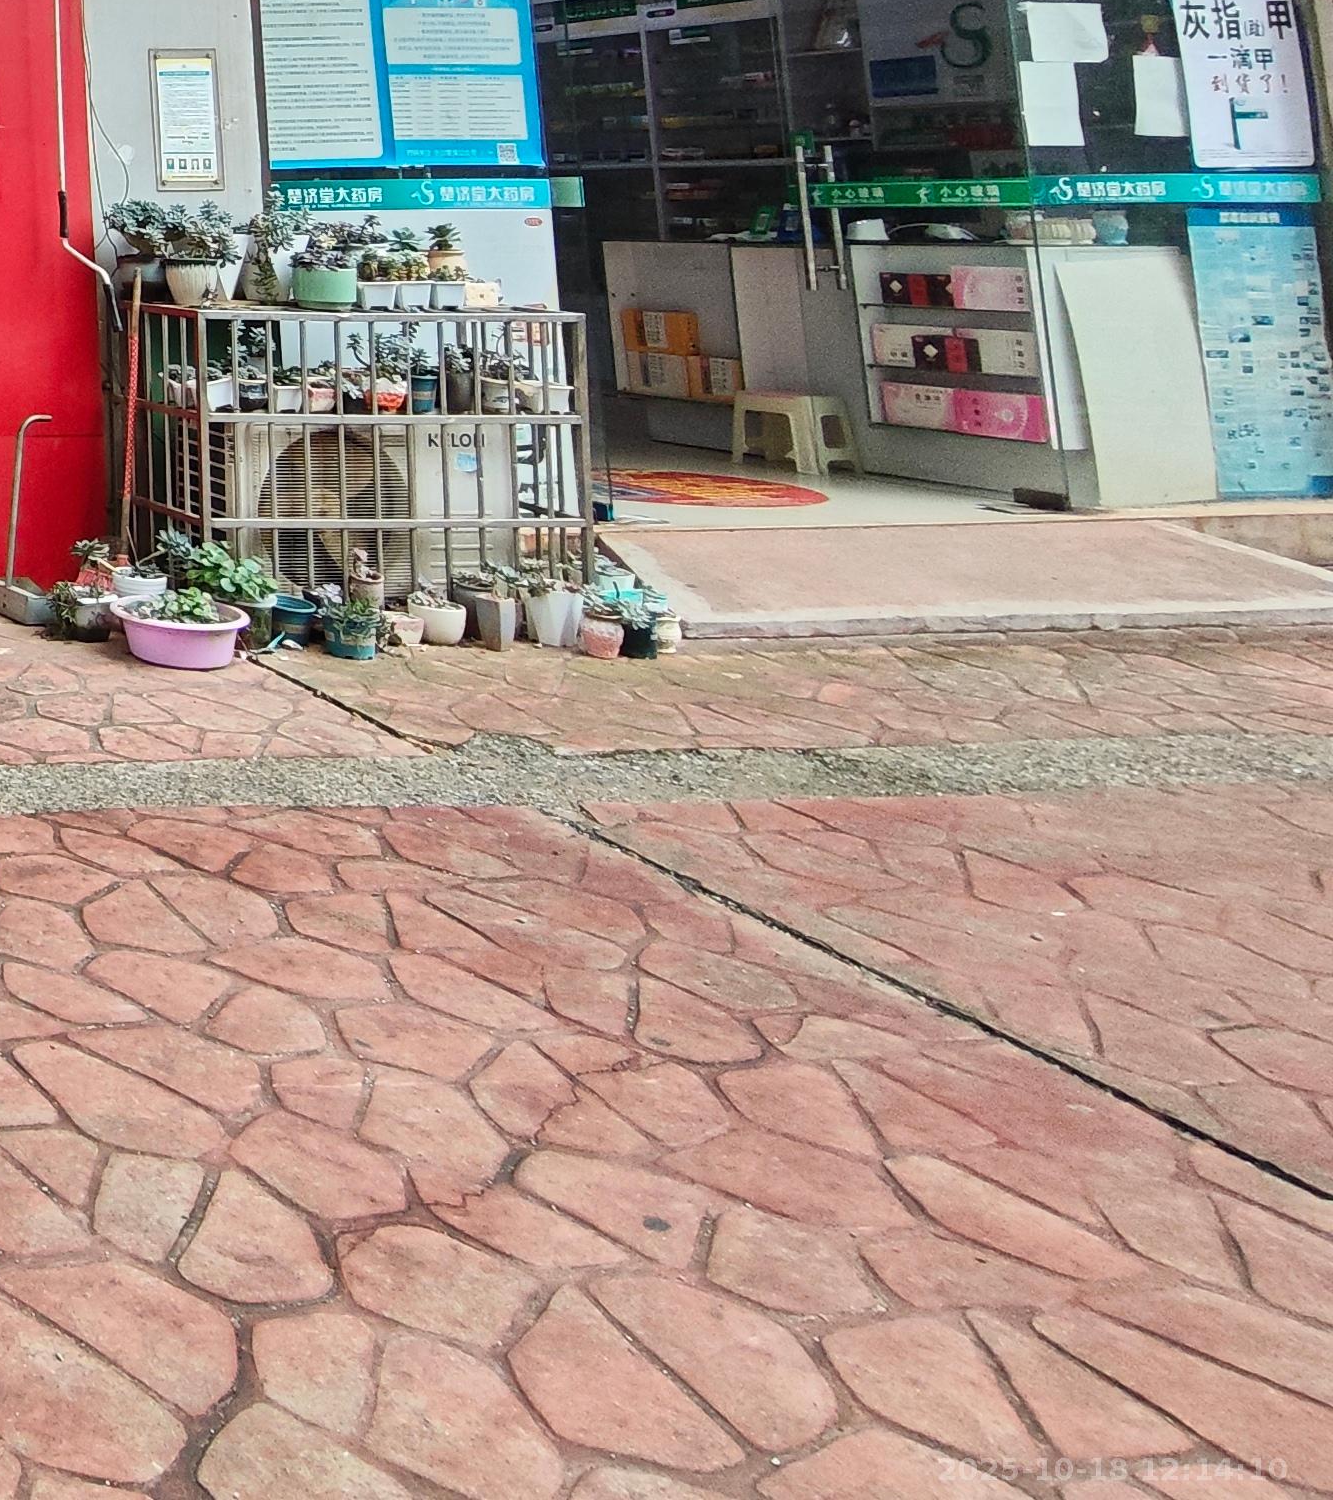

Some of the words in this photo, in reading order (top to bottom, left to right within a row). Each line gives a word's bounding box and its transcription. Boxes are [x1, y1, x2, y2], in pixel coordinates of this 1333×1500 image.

[286, 186, 383, 205] 楚济堂大药房
[439, 185, 535, 203] 楚济堂大药房
